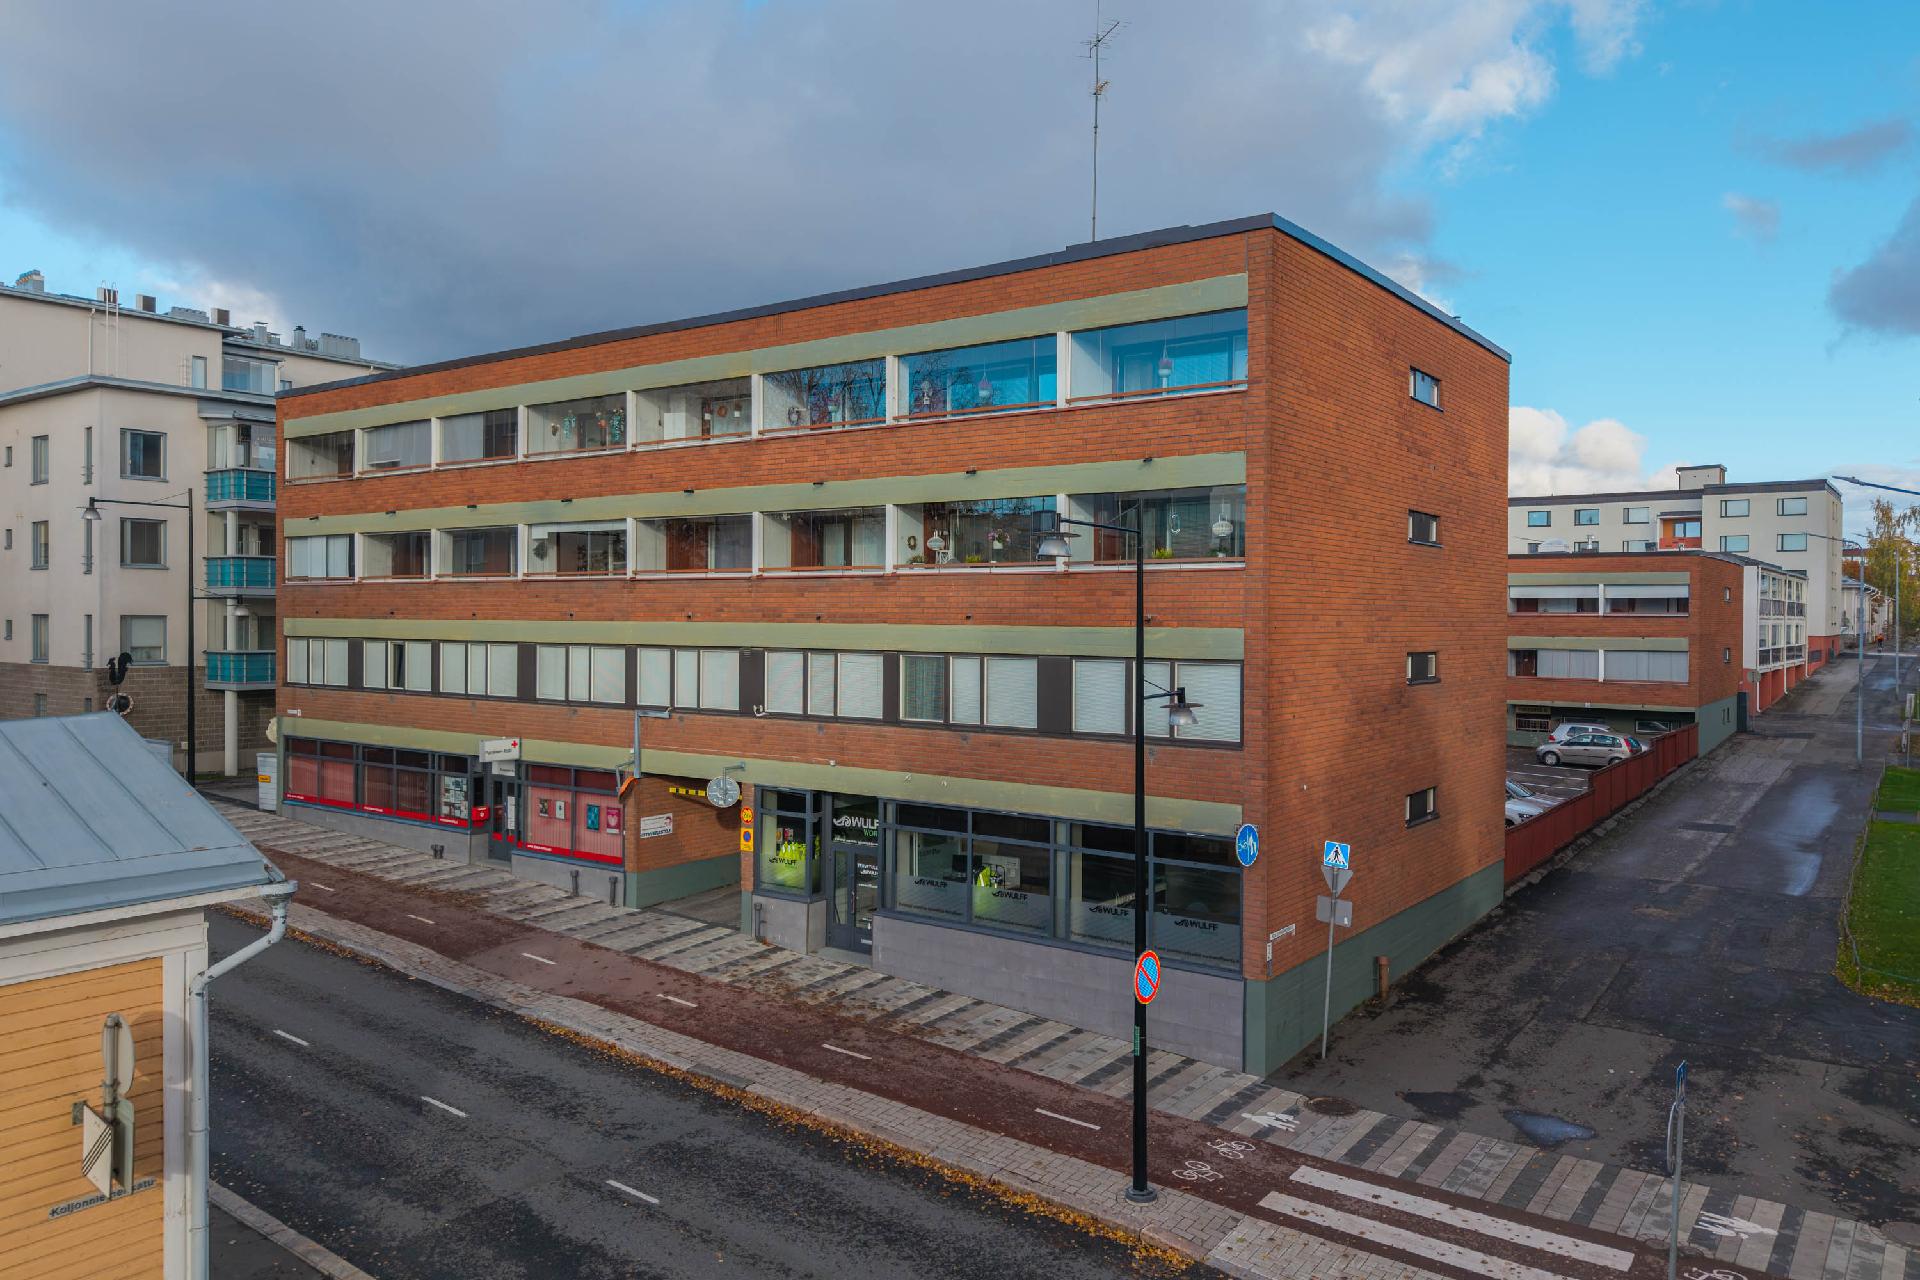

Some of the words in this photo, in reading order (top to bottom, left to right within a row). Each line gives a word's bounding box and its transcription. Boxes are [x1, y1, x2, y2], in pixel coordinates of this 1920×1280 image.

[1004, 891, 1028, 901] WULFF
[1102, 906, 1129, 916] WULFF
[1189, 919, 1219, 931] WULFF
[50, 1178, 155, 1217] Koljonnieeatu
